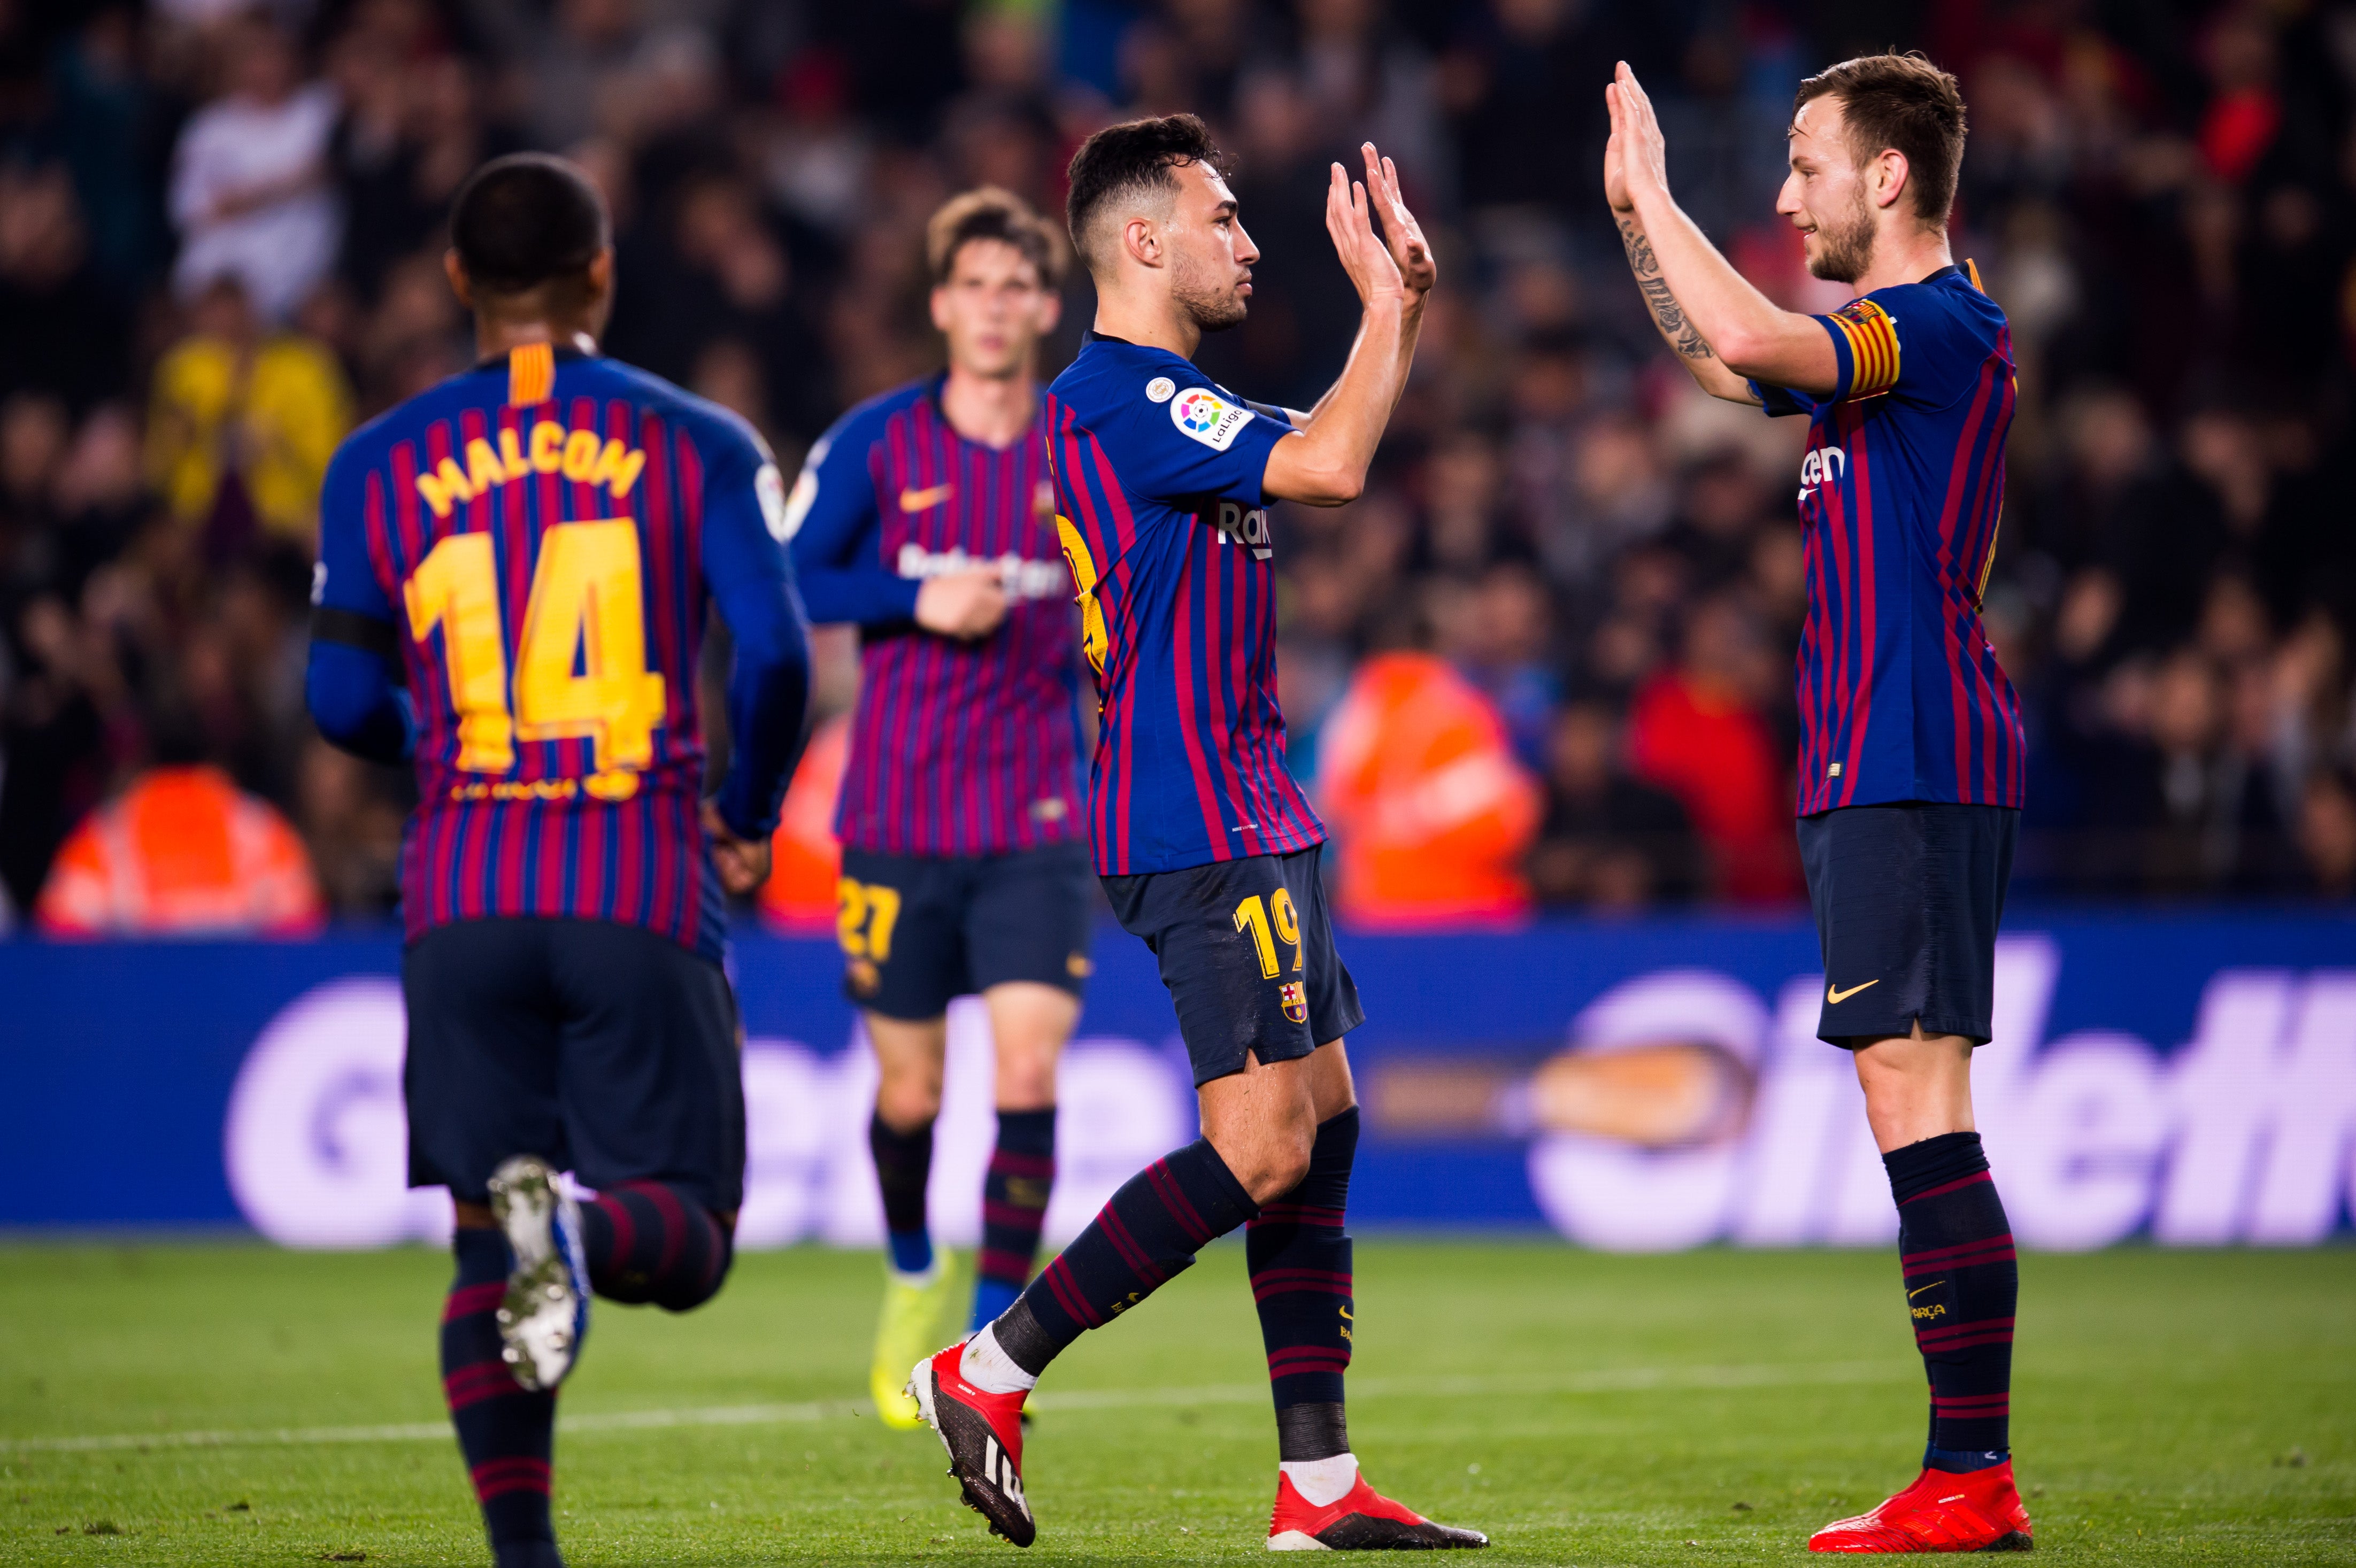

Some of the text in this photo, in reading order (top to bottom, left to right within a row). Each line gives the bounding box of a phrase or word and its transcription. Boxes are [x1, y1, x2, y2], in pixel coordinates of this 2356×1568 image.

[418, 421, 645, 517] MALCOM
[1213, 410, 1242, 443] LaLiga
[404, 517, 666, 773] 14
[836, 876, 902, 962] 27
[1233, 887, 1302, 979] 19
[1910, 1304, 1946, 1319] ARÇA
